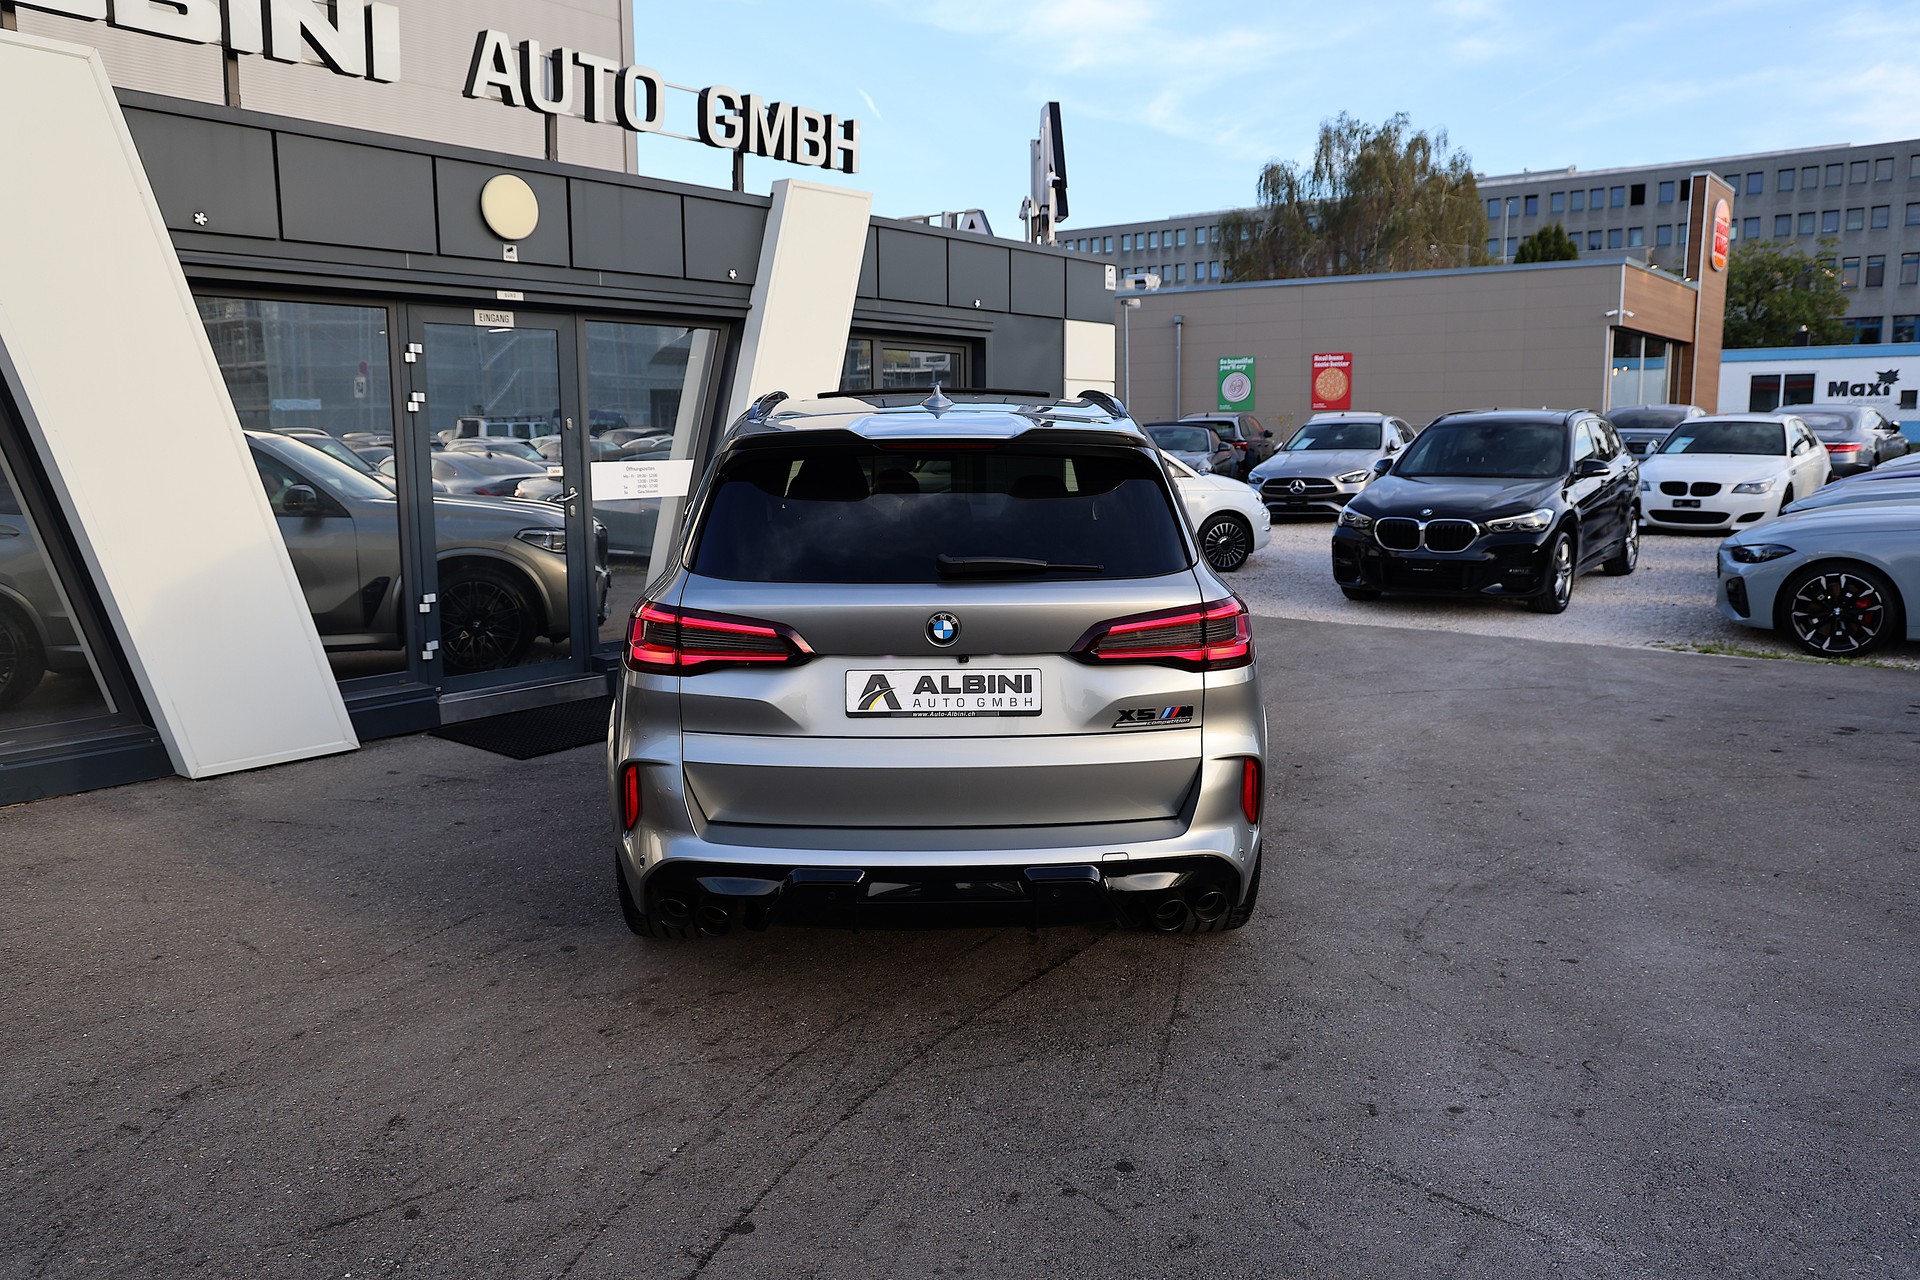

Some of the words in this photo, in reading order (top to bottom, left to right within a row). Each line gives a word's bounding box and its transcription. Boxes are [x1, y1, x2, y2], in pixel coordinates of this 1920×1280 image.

[0, 0, 401, 84] INI
[463, 28, 665, 132] AUTO
[698, 85, 861, 174] GMBH
[478, 312, 510, 324] EINGANG
[1827, 379, 1892, 397] Maxi
[930, 613, 957, 625] BMW
[912, 674, 1033, 695] ALBINI
[912, 697, 966, 708] AUTO
[976, 697, 1033, 708] GMBH
[1116, 707, 1156, 722] X5
